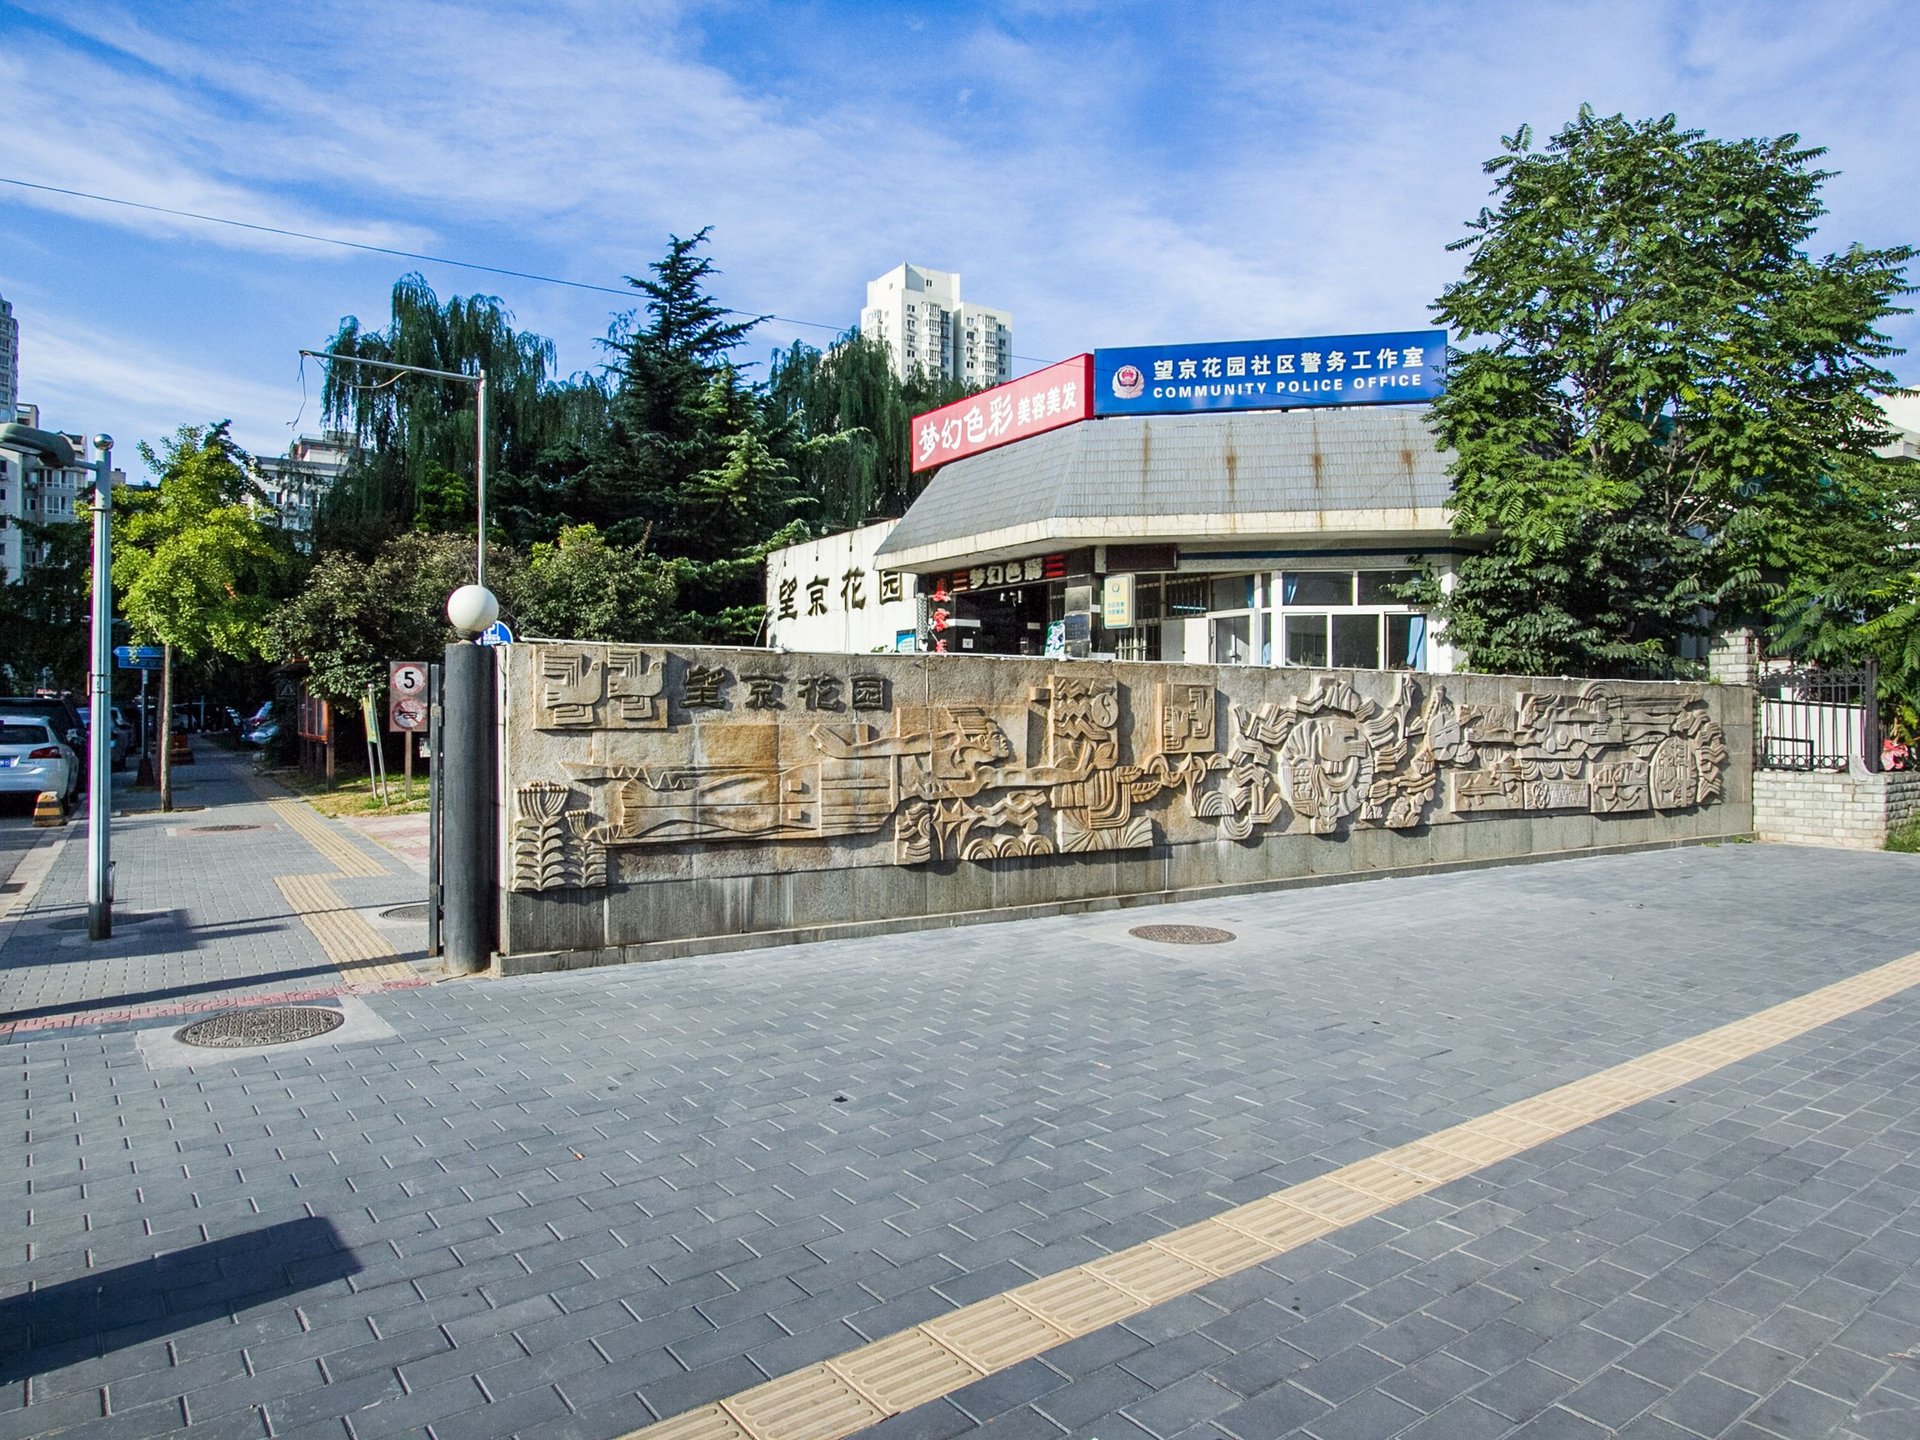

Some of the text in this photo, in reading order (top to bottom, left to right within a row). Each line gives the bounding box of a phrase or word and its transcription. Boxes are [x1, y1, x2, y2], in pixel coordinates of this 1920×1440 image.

[1153, 346, 1424, 381] 望京花园社区警务工作室
[1153, 374, 1422, 399] COMMUNITY POLICE OFFICE
[918, 381, 1078, 462] 梦幻色彩 美容美发
[969, 558, 1043, 590] 梦幻色彩
[777, 565, 903, 622] 望京花园
[403, 671, 416, 689] 5
[679, 663, 887, 711] 望京花园
